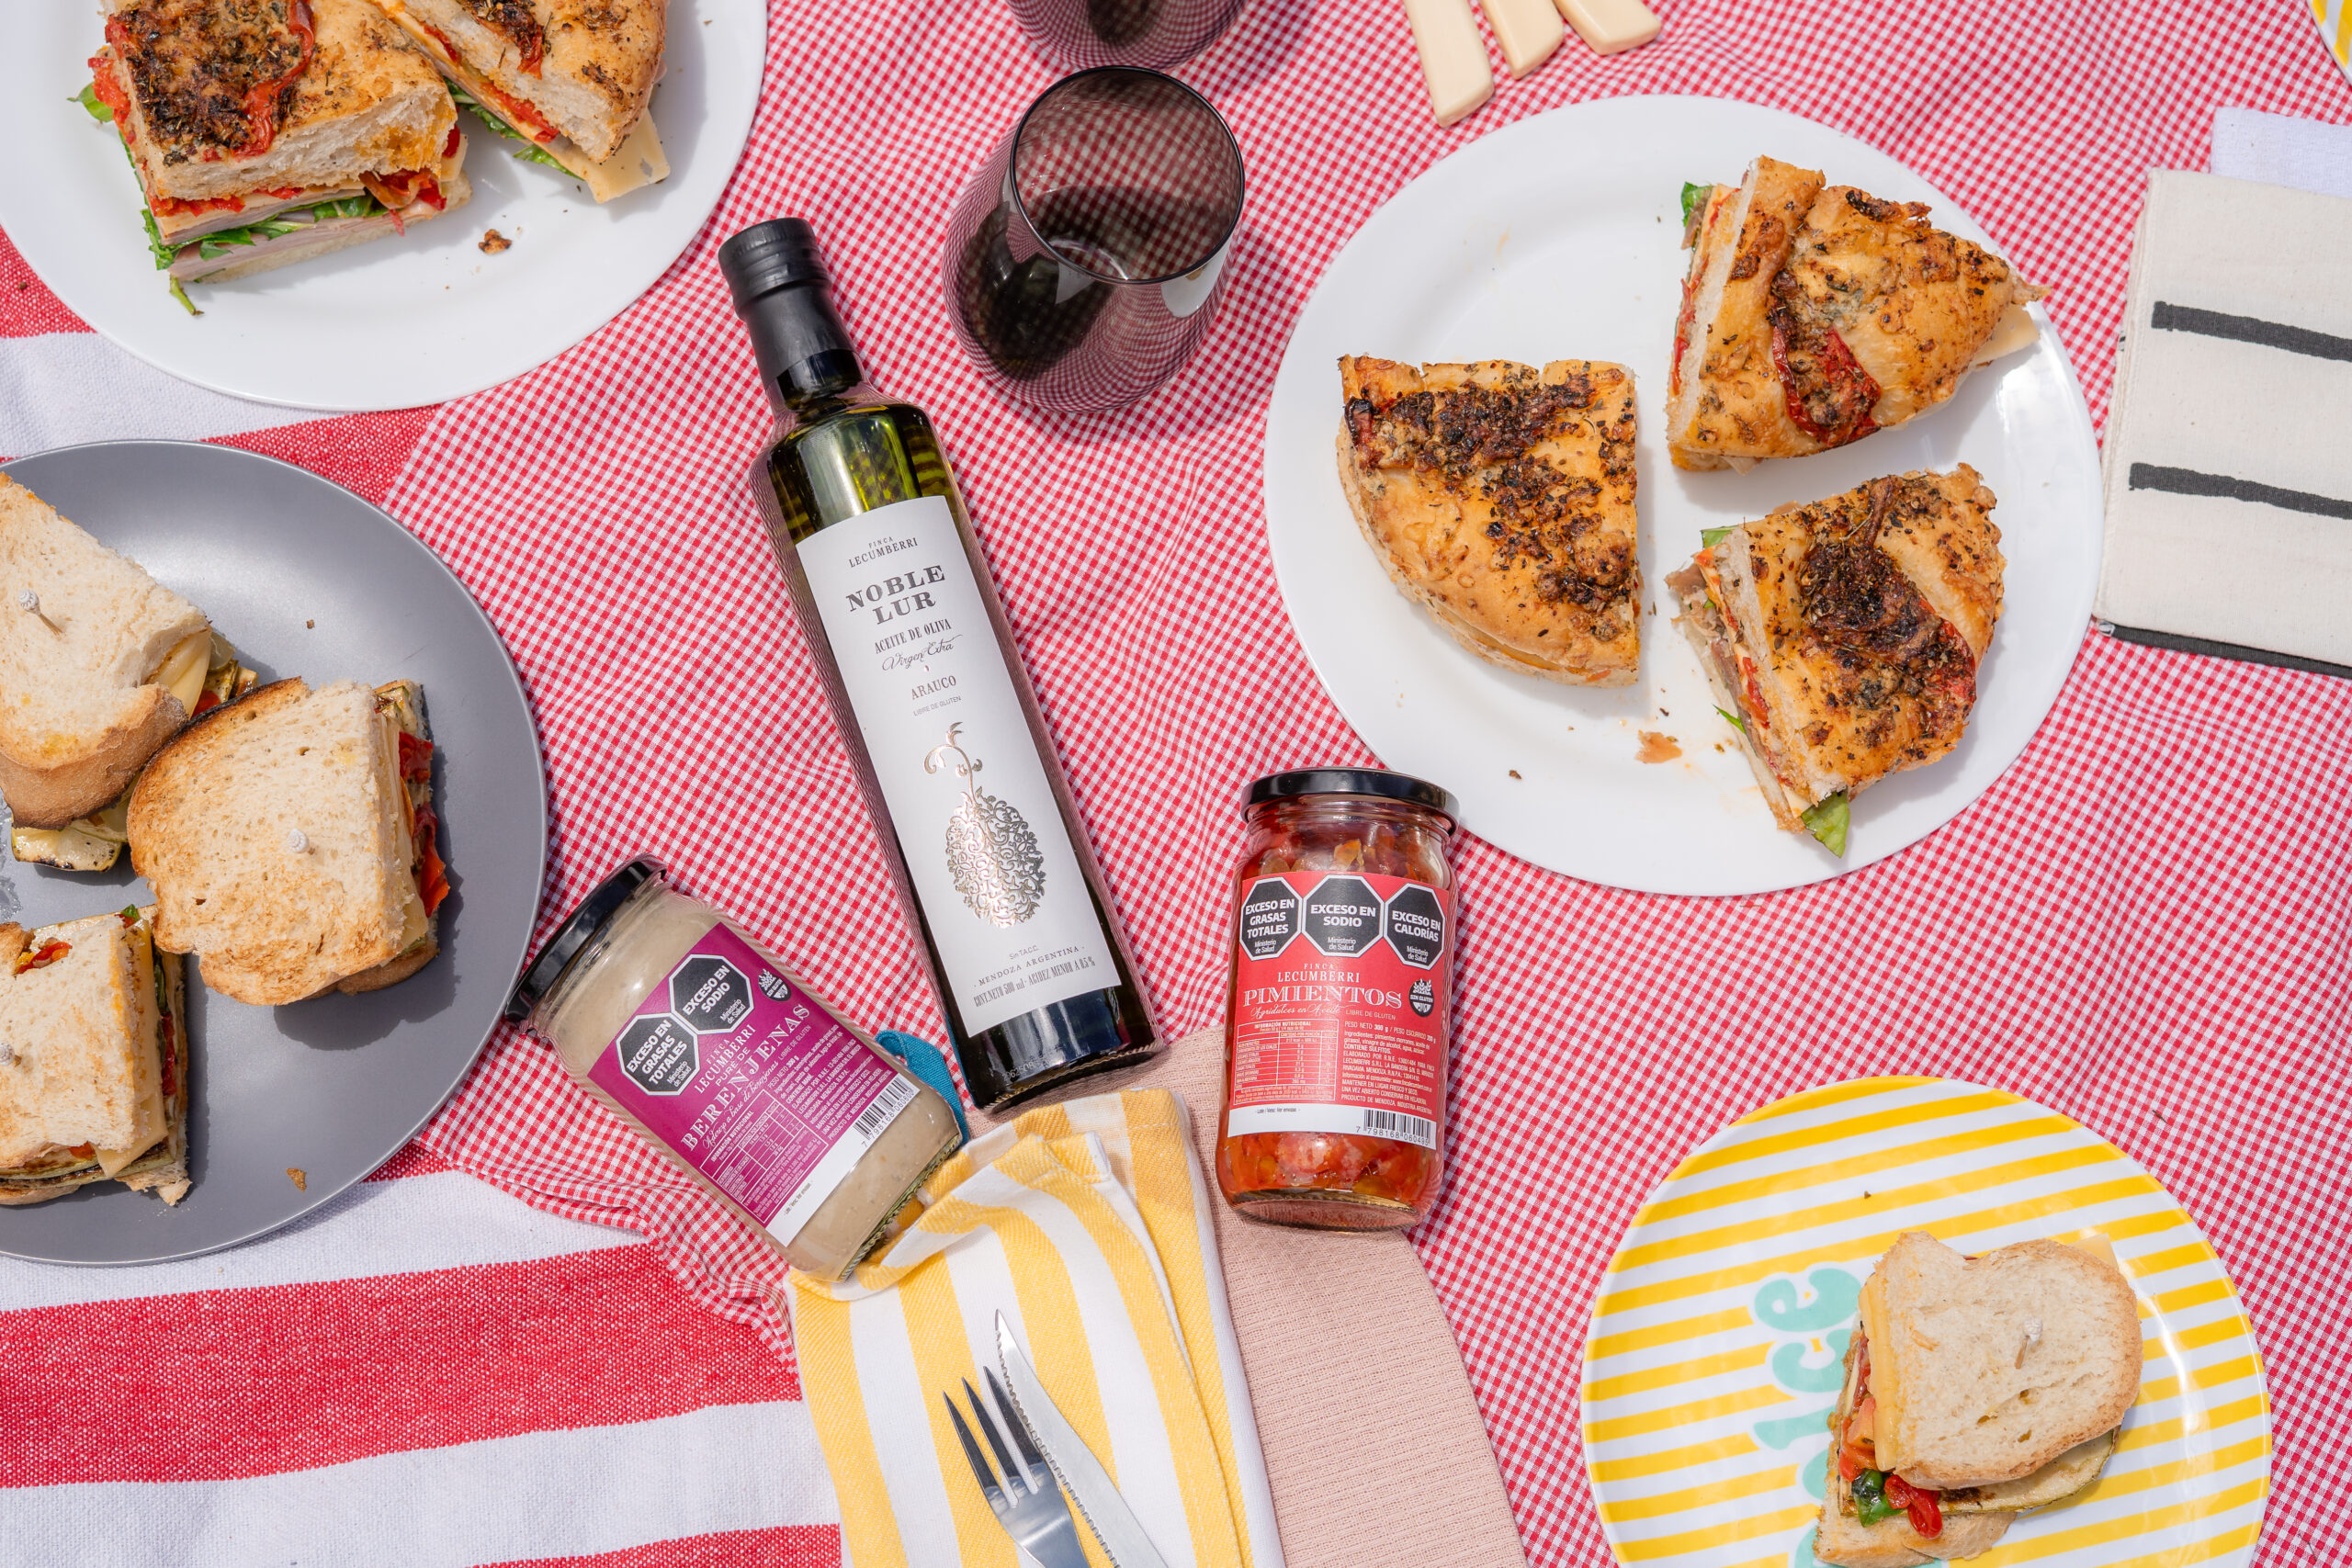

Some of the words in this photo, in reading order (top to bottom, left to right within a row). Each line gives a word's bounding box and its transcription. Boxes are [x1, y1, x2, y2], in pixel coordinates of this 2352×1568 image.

[849, 537, 918, 568] LECUMBERRI
[868, 536, 893, 548] FINCA
[845, 565, 945, 612] NOBLE
[872, 592, 936, 625] LUR
[875, 632, 907, 654] ACEITE
[908, 626, 922, 640] DE
[924, 619, 952, 635] OLIVA
[882, 652, 924, 671] Virgen
[927, 634, 961, 656] Extra
[911, 675, 956, 700] ARAUCO
[913, 705, 931, 716] LIBRE
[939, 695, 962, 707] GLUTEN
[1246, 900, 1278, 915] EXCESO
[1280, 898, 1295, 908] EN
[1310, 904, 1357, 915] EXCESO
[1359, 906, 1376, 917] EN
[1250, 912, 1286, 926] GRASAS
[1323, 916, 1362, 927] SODIO
[1392, 910, 1430, 927] EXCESO
[1430, 919, 1441, 931] EN
[1247, 924, 1288, 939] TOTALES
[1328, 936, 1356, 944] Ministerio
[1395, 923, 1441, 942] CALORÍAS
[1255, 940, 1277, 948] Ministerio
[1261, 945, 1275, 953] Salud
[1337, 943, 1354, 953] Salud
[1407, 945, 1429, 957] Ministerio
[978, 964, 1022, 987] MENDOZA
[1026, 946, 1080, 967] ARGENTINA
[1414, 954, 1427, 963] Salud
[1003, 981, 1015, 995] 500
[1028, 968, 1051, 985] ACIDEZ
[1050, 962, 1074, 976] MENOR
[1074, 961, 1080, 970] A
[1278, 971, 1361, 984] LECUMBERRI
[682, 977, 718, 1016] EXCESO
[714, 964, 729, 981] EN
[701, 982, 729, 1013] SODIO
[1243, 986, 1402, 1010] PIMIENTOS
[719, 999, 741, 1021] Ministerio
[728, 1016, 735, 1024] de
[731, 1003, 746, 1018] Salud
[1250, 1003, 1295, 1019] Agridulces
[789, 1039, 797, 1047] DE
[796, 1025, 811, 1042] GLUTEN
[627, 1035, 659, 1073] EXCESO
[654, 1020, 672, 1038] EN
[641, 1034, 675, 1074] GRASAS
[706, 1039, 729, 1065] FINCA
[777, 1045, 792, 1061] LIBRE
[1343, 1042, 1367, 1051] CONTIENE
[649, 1040, 687, 1084] TOTALES
[695, 1024, 755, 1093] LECUMBERRI
[715, 1060, 739, 1087] PURÉ
[737, 1047, 751, 1061] DE
[667, 1061, 687, 1084] Ministerio
[673, 1079, 682, 1088] de
[678, 1066, 692, 1081] Salud
[682, 1004, 809, 1151] BERENJENAS
[746, 1060, 779, 1094] berenjenas
[767, 1077, 779, 1089] PESO
[776, 1066, 788, 1078] NETO
[786, 1058, 796, 1068] 300
[742, 1089, 752, 1102] de
[726, 1100, 744, 1118] base
[703, 1122, 727, 1148] Aderezo
[729, 1111, 754, 1138] NUTRICIONAL
[1366, 1128, 1399, 1138] 798168
